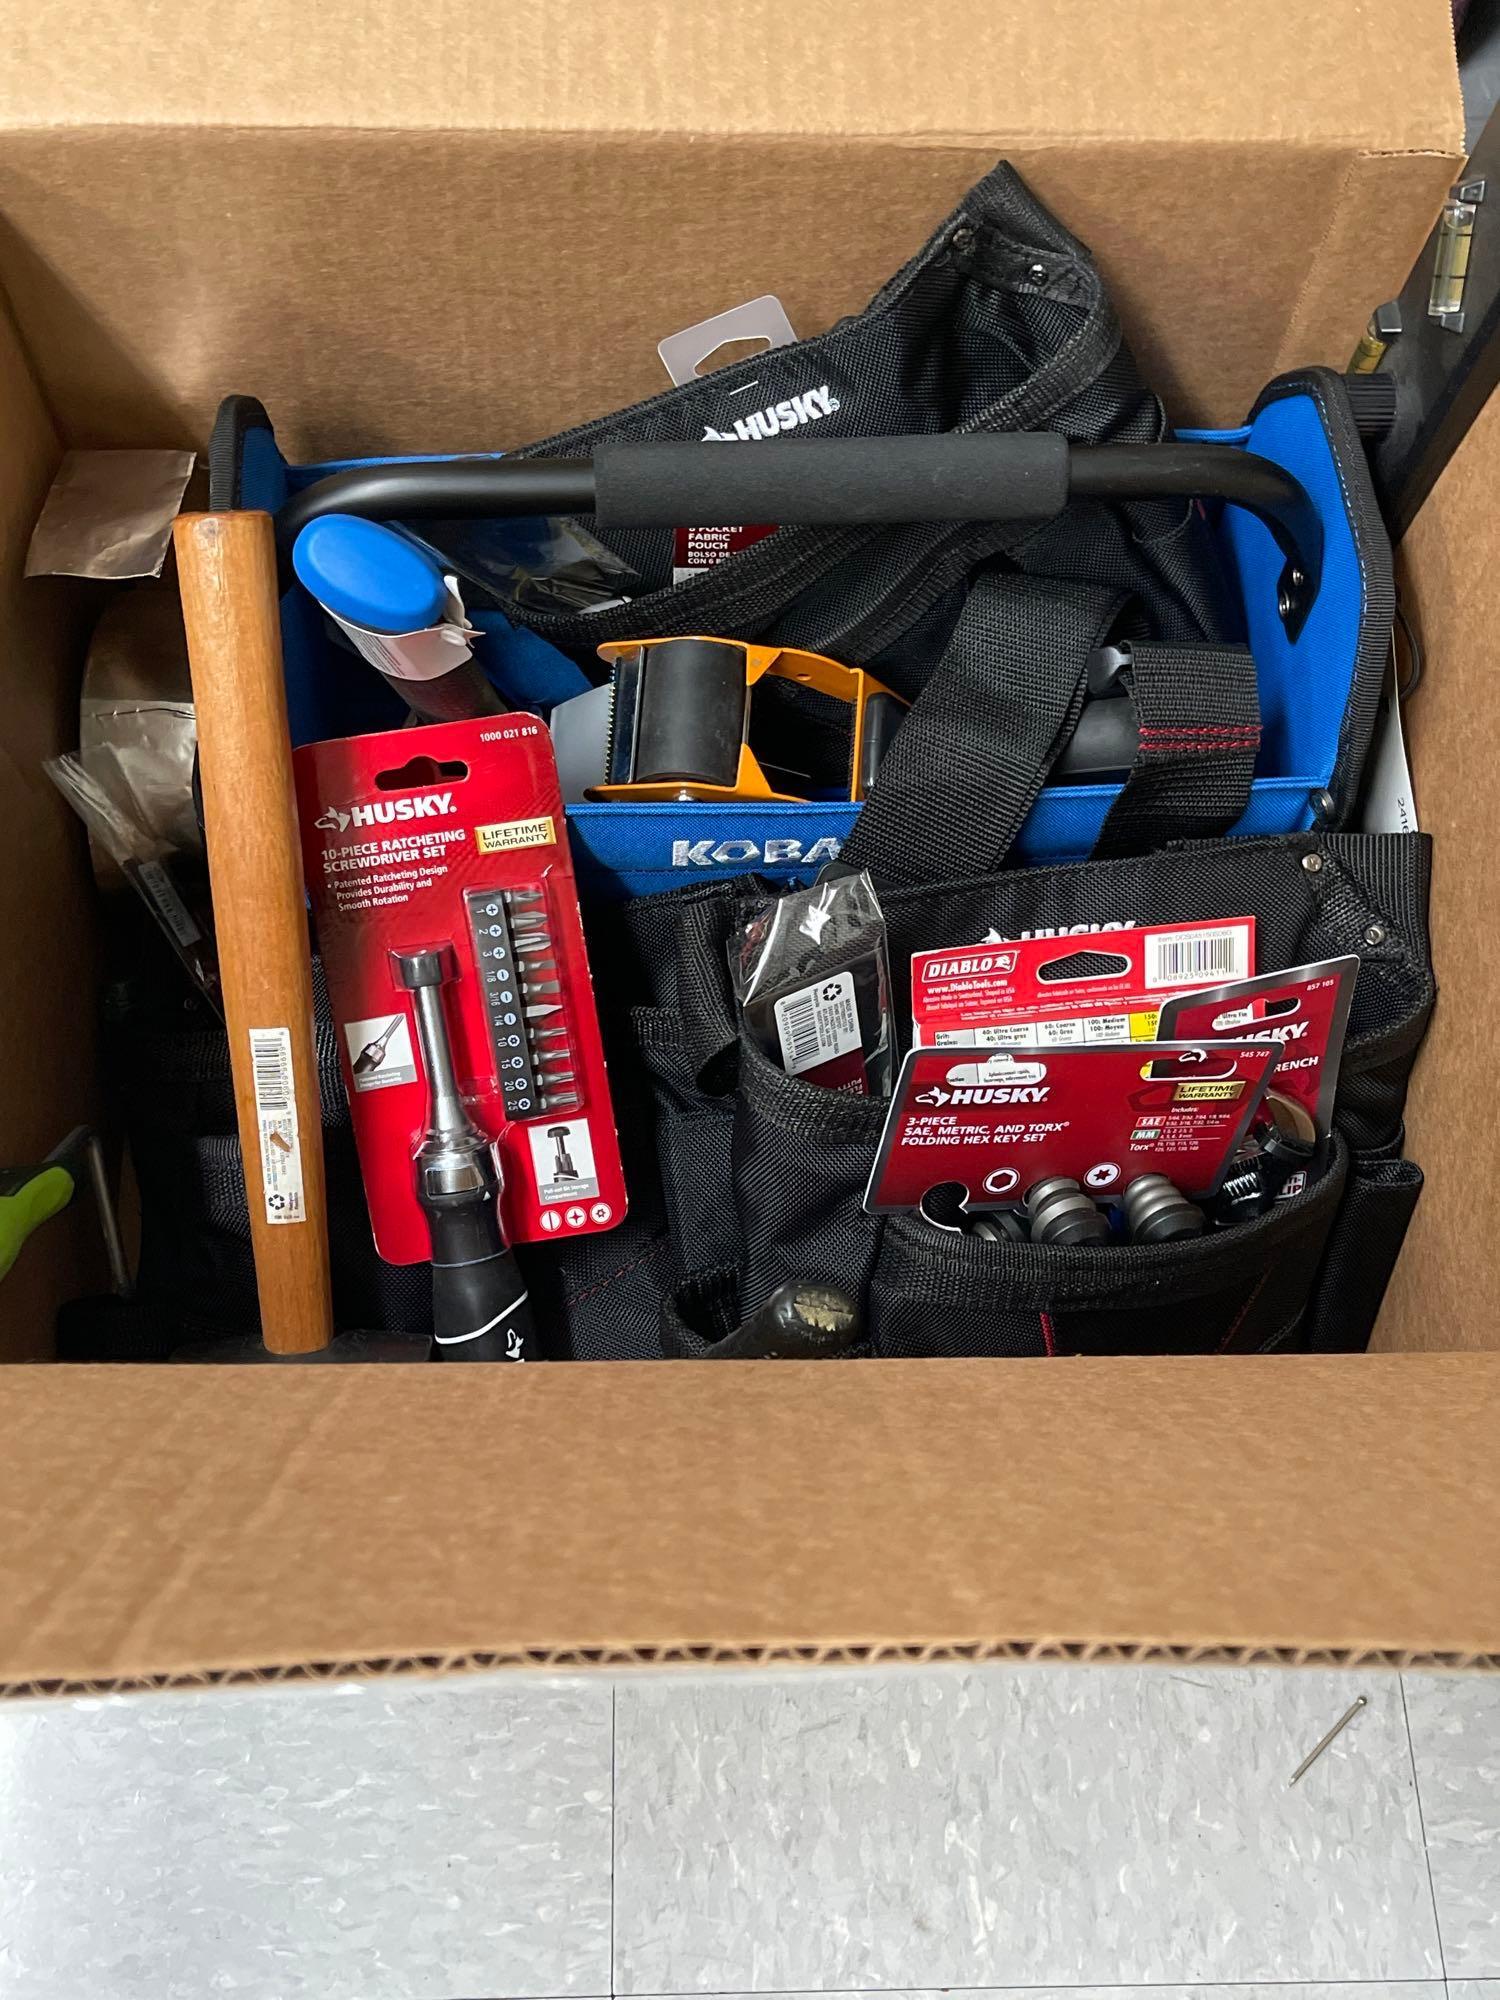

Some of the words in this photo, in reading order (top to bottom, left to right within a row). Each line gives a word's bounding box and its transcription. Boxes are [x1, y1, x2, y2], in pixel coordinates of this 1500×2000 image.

[687, 533, 731, 541] FABRIC
[687, 541, 728, 549] POUCH
[480, 730, 502, 742] 1000
[504, 728, 520, 740] 021
[521, 726, 538, 737] 816
[350, 792, 452, 827] HUSKY
[482, 822, 548, 841] LIFETIME
[321, 840, 379, 861] 10-PIECE
[382, 829, 466, 850] RATCHETING
[484, 832, 549, 849] WARRANTY
[672, 838, 842, 866] KOBA
[323, 851, 421, 874] SCREWDRIVER
[423, 845, 447, 859] SET
[334, 875, 372, 889] Patented
[372, 868, 418, 886] Ratcheting
[419, 864, 448, 880] Design
[336, 886, 373, 901] Provides
[374, 880, 412, 896] Durability
[413, 878, 432, 890] and
[338, 899, 370, 912] Smooth
[373, 893, 408, 906] Rotation
[482, 950, 492, 958] 3
[928, 957, 992, 978] DIABLO
[486, 970, 496, 983] 1/8
[927, 979, 1008, 994] www.DiabloTools.com
[494, 1014, 504, 1027] 1/4
[1102, 1016, 1126, 1024] Medium
[1104, 1024, 1124, 1032] Moyen
[497, 1037, 508, 1048] 10
[1256, 1050, 1270, 1058] 747
[501, 1058, 511, 1070] 15
[1274, 1056, 1318, 1072] RENCH
[504, 1080, 515, 1092] 20
[950, 1087, 1050, 1104] HUSKY
[507, 1100, 518, 1112] 25
[906, 1116, 957, 1126] 3-PIECE
[1142, 1118, 1162, 1126] SAE
[904, 1126, 934, 1136] SAE,
[938, 1126, 990, 1136] METRIC,
[994, 1124, 1025, 1134] AND
[1136, 1130, 1155, 1138] MM
[901, 1136, 960, 1146] FOLDING
[963, 1135, 990, 1144] HEX
[992, 1134, 1020, 1143] KEY
[1022, 1133, 1046, 1142] SET
